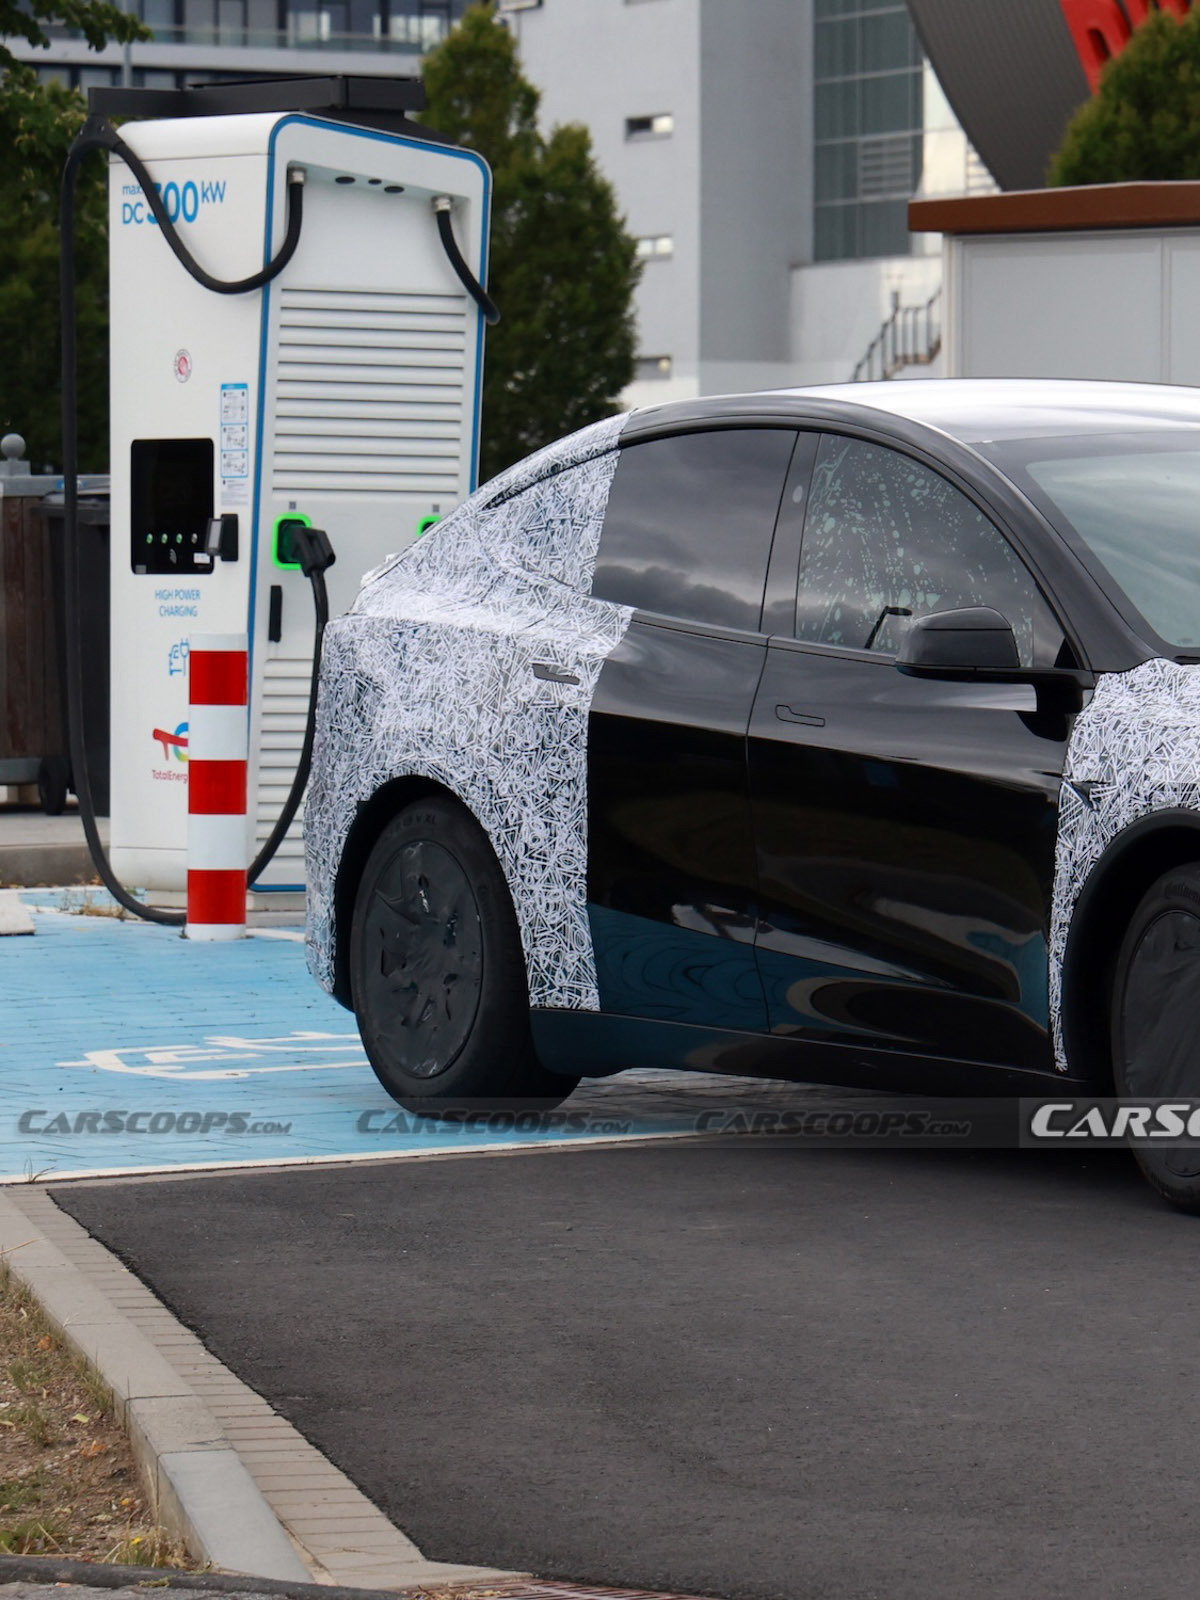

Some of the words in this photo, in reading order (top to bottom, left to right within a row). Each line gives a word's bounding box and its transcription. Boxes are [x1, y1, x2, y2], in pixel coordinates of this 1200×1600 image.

[122, 202, 144, 224] DC
[201, 180, 226, 203] kW
[155, 589, 173, 600] HIGH
[174, 589, 201, 600] POWER
[159, 605, 198, 617] CHARGING
[152, 769, 189, 785] TotalEnerg
